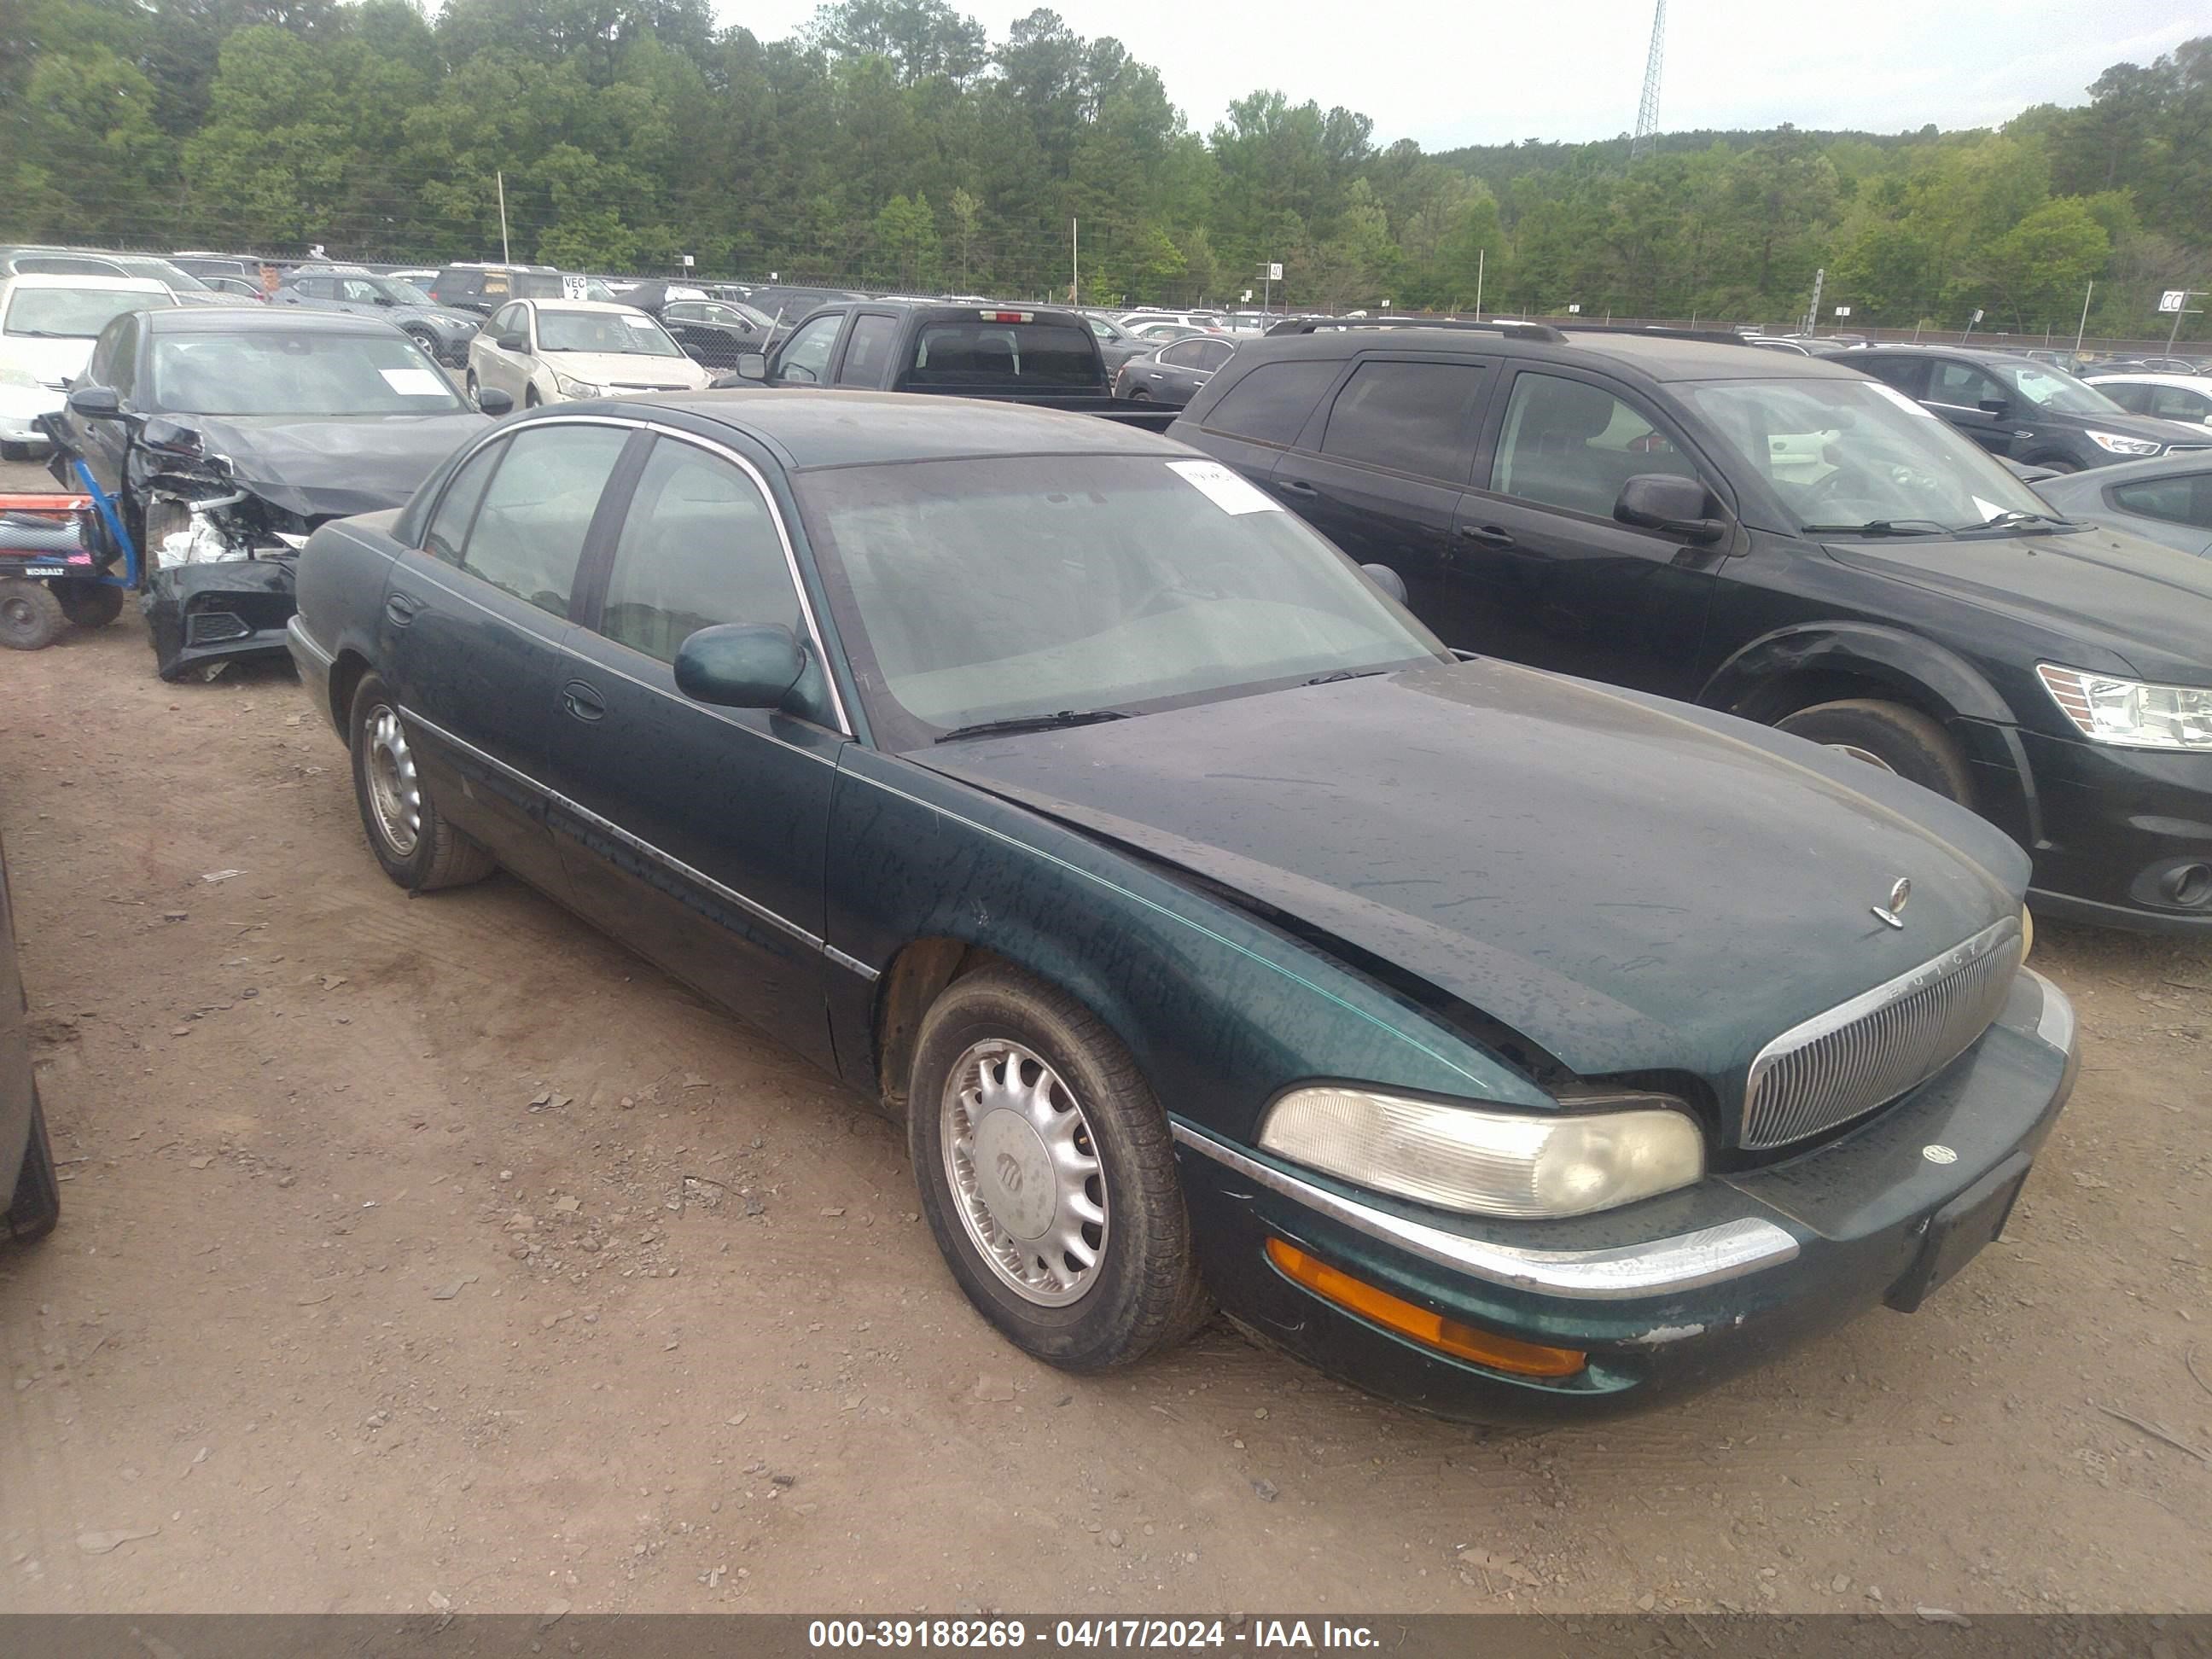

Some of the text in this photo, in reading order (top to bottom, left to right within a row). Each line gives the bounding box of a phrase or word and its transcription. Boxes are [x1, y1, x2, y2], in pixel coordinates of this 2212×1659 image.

[1272, 265, 1282, 278] 40
[564, 277, 585, 288] VEC
[573, 288, 579, 300] 2
[2162, 294, 2182, 310] CC
[26, 568, 64, 576] KOBALT
